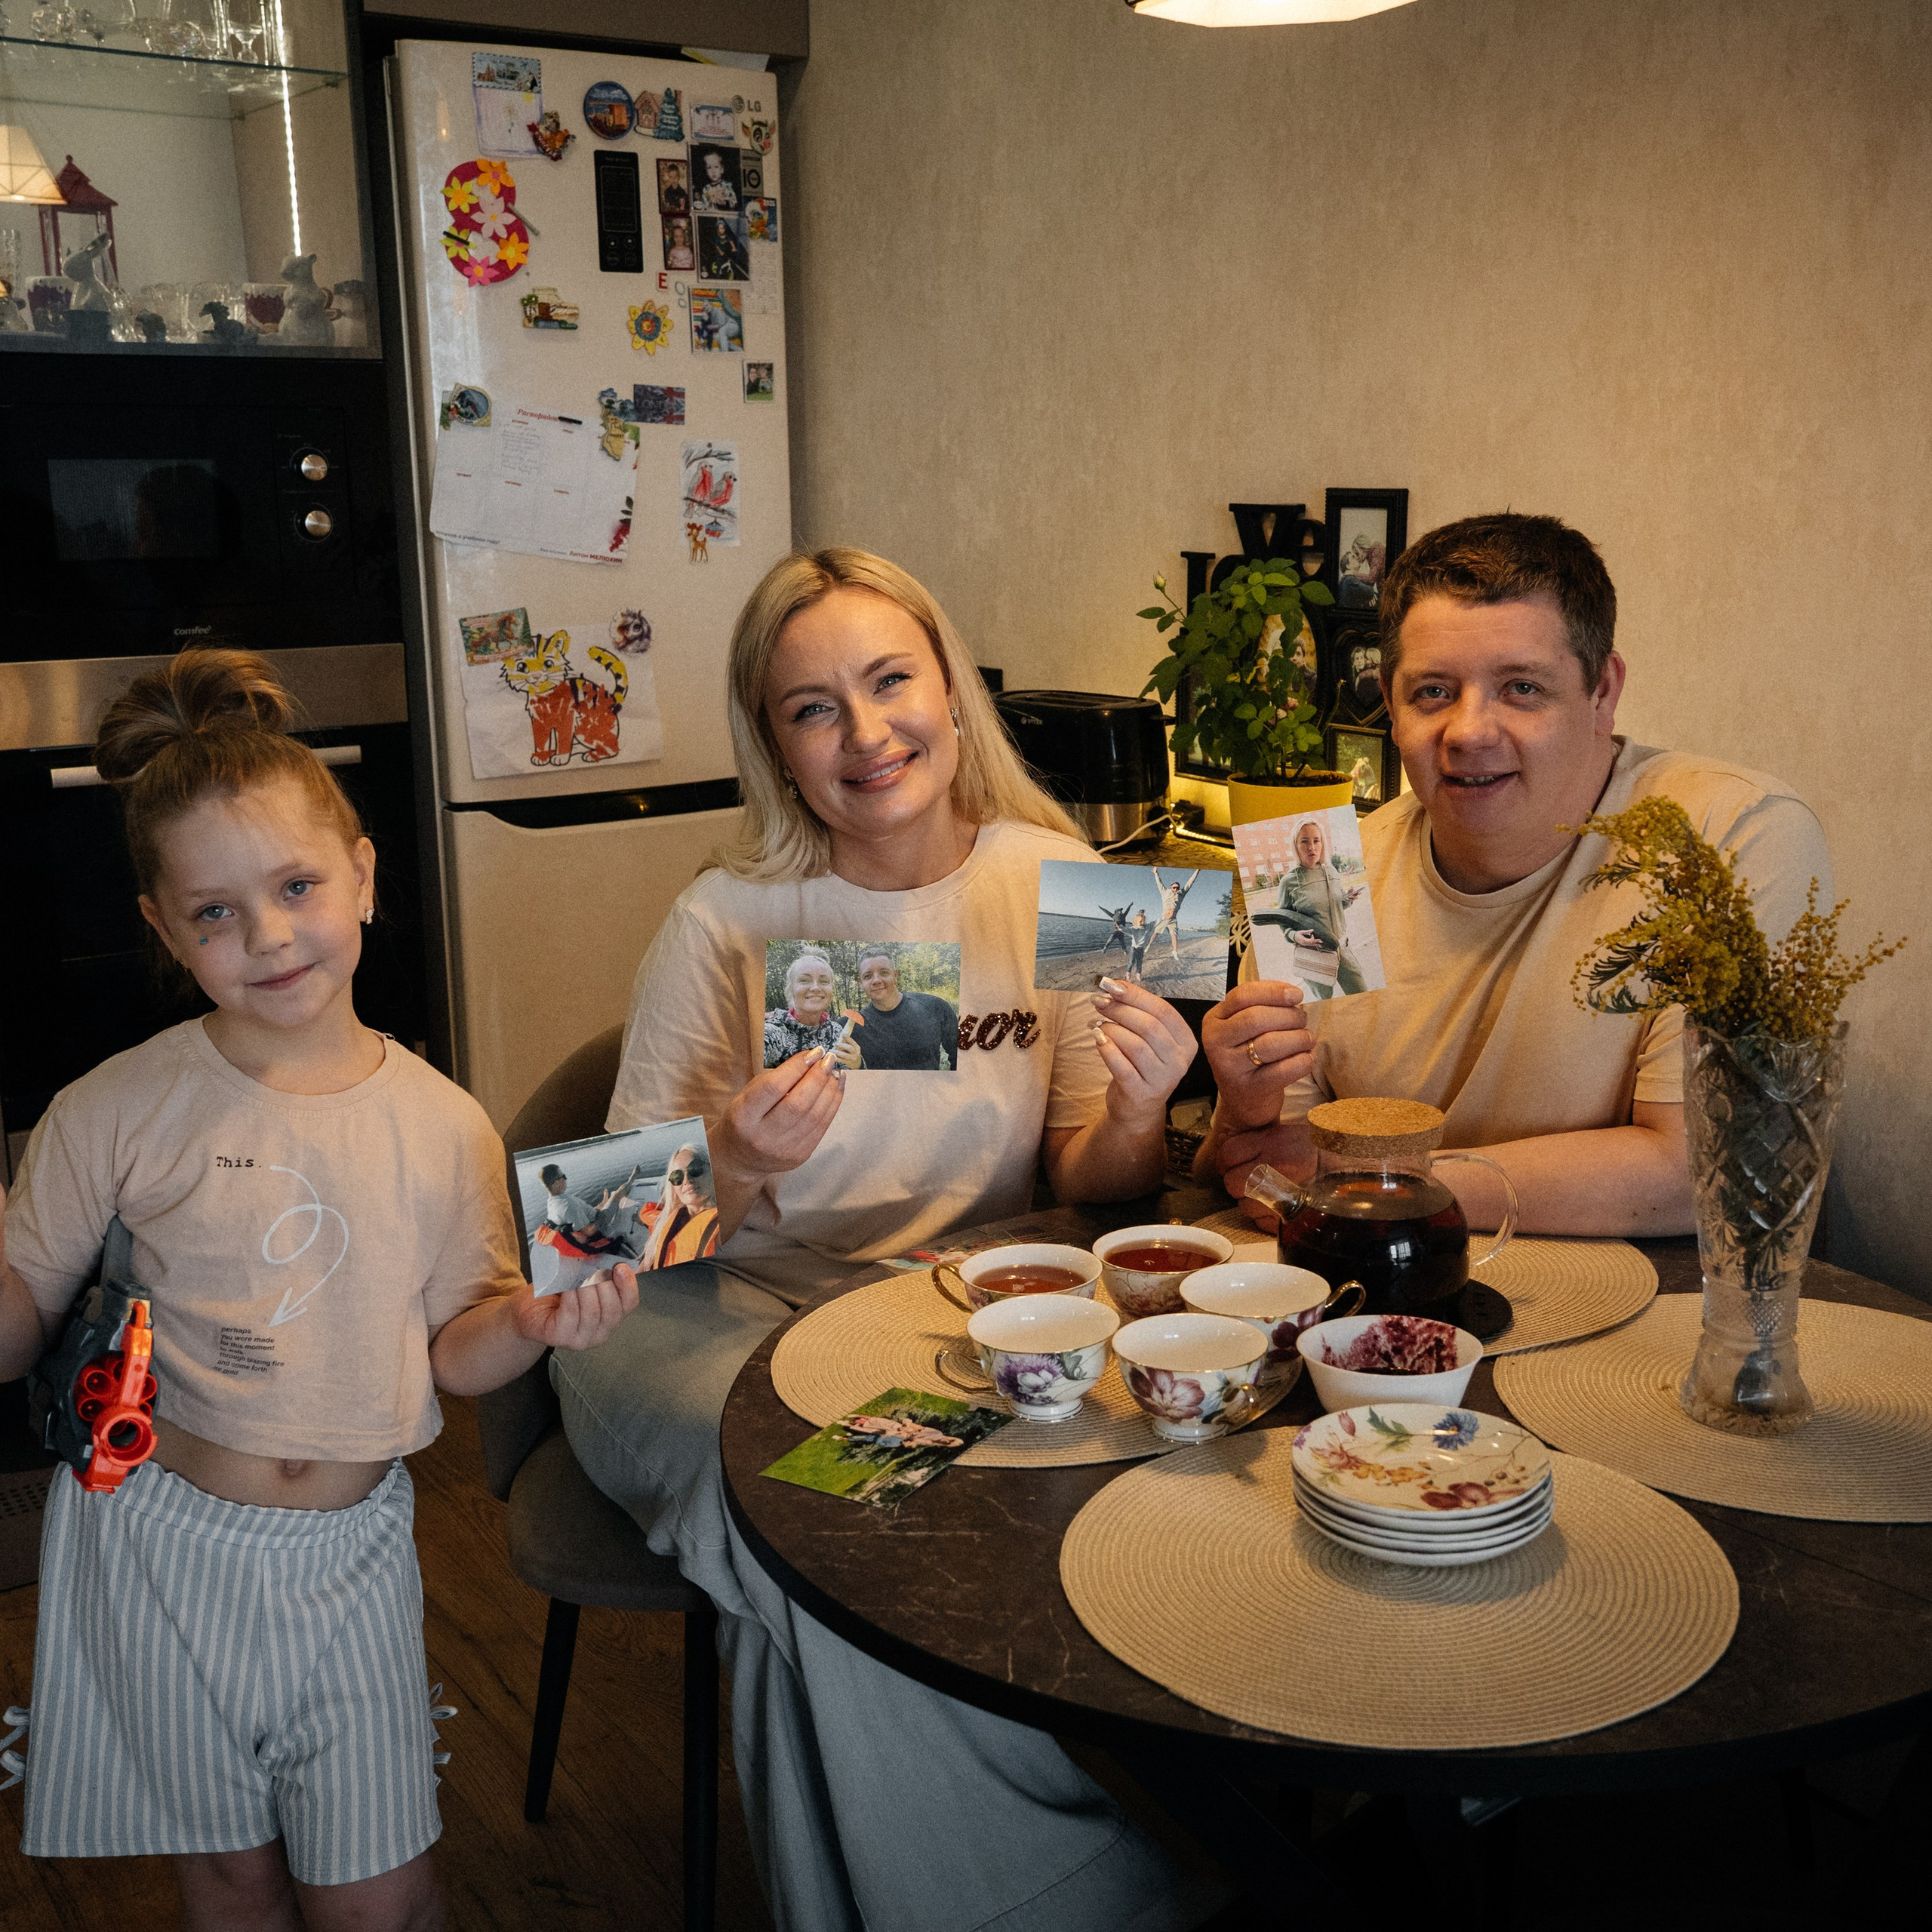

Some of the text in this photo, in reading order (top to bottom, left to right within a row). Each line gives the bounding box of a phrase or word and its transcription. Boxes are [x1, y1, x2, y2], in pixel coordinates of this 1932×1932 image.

[748, 100, 761, 112] LG
[658, 272, 668, 290] E
[220, 1352, 246, 1362] through
[247, 1356, 271, 1367] blazing
[231, 1361, 251, 1370] come
[251, 1364, 268, 1373] forth
